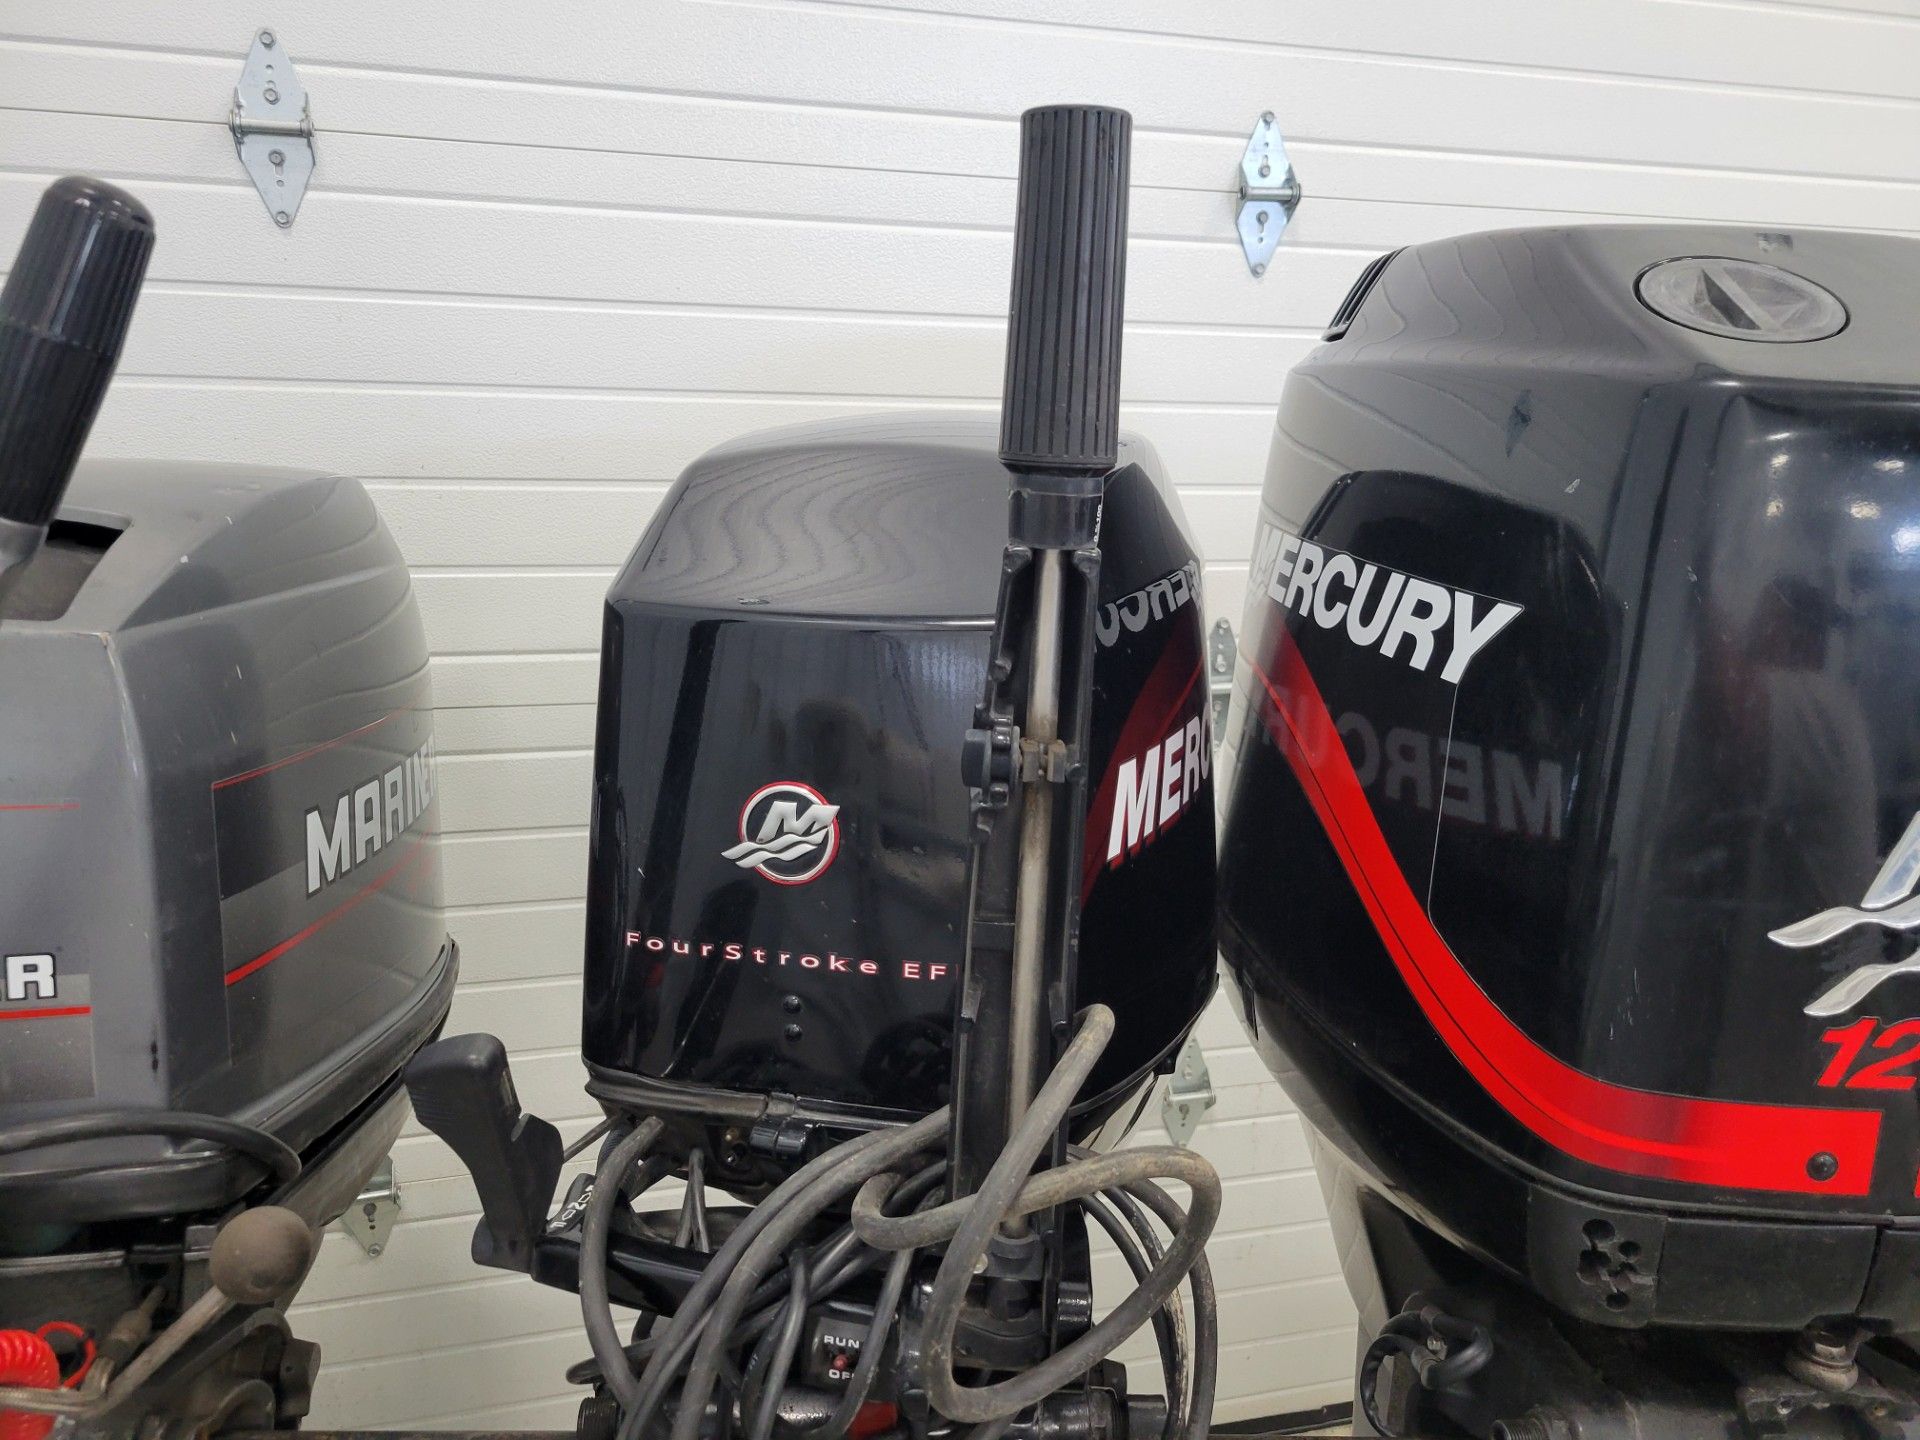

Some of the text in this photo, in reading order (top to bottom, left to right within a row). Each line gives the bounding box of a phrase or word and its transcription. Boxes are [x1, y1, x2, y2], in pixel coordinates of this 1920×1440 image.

[1250, 523, 1524, 685] MERCURY
[625, 930, 959, 981] FourStroke EF
[1817, 1016, 1920, 1090] 12
[823, 1334, 860, 1349] RUN
[828, 1368, 855, 1380] OF
